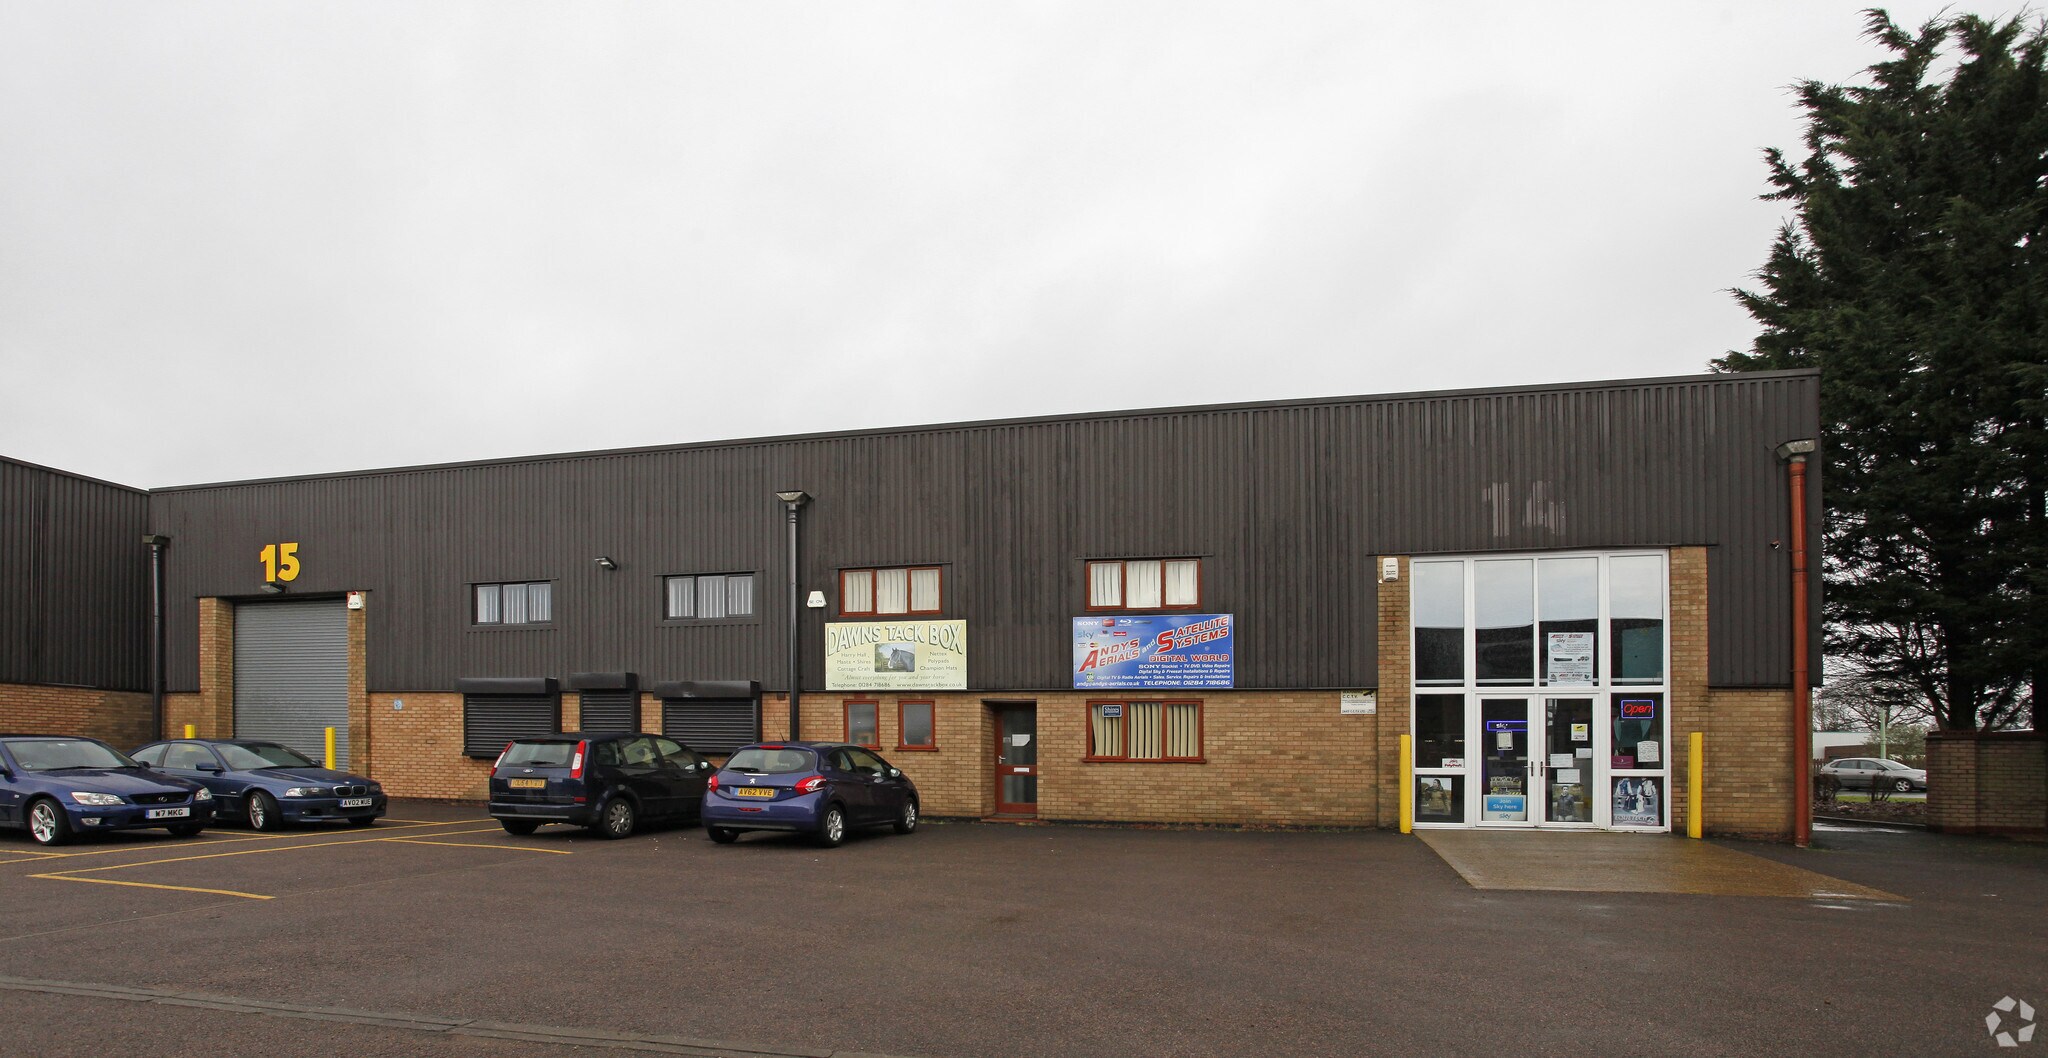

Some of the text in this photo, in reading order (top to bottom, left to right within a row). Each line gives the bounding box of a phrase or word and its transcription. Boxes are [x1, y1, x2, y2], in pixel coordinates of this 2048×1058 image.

[260, 542, 300, 582] 15
[827, 624, 963, 657] DAWNS TACK BOX
[1077, 630, 1095, 640] sky
[1141, 639, 1156, 653] and
[1149, 654, 1229, 662] DIGITAL WORLD
[1624, 704, 1652, 715] Open
